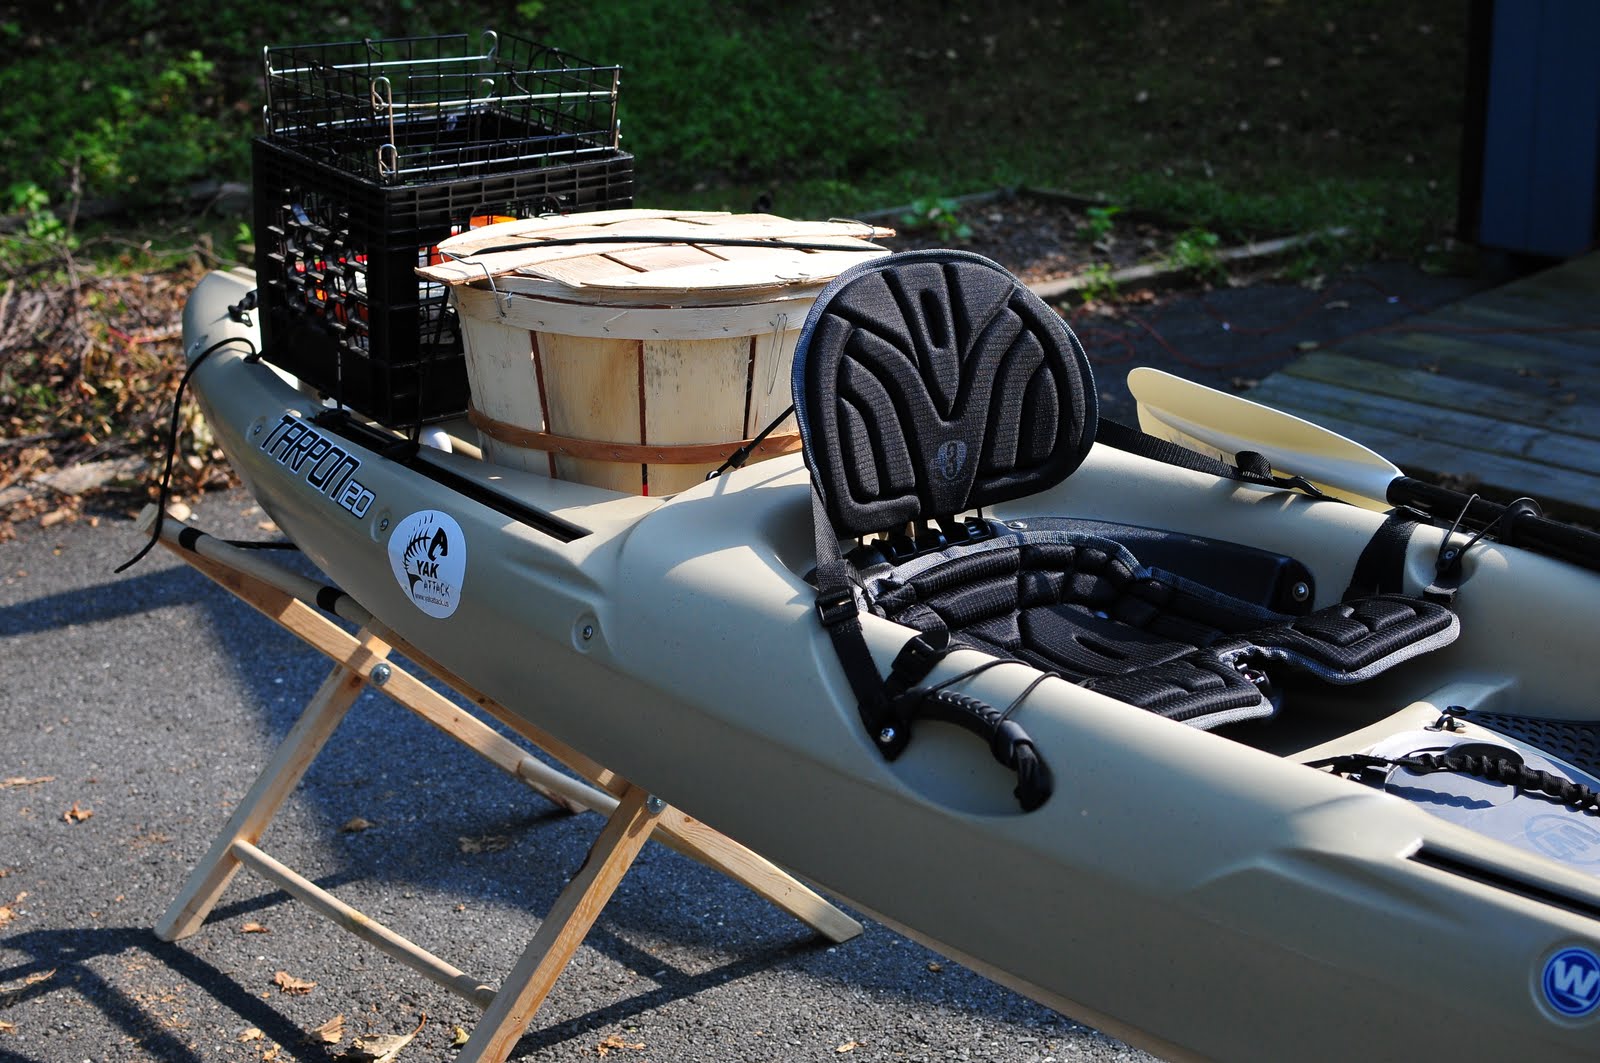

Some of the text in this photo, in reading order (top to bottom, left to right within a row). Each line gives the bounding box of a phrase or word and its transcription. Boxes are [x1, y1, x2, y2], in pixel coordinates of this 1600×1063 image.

[260, 412, 376, 519] TARPON 120
[417, 560, 439, 579] YAK
[423, 580, 450, 598] ATTACK
